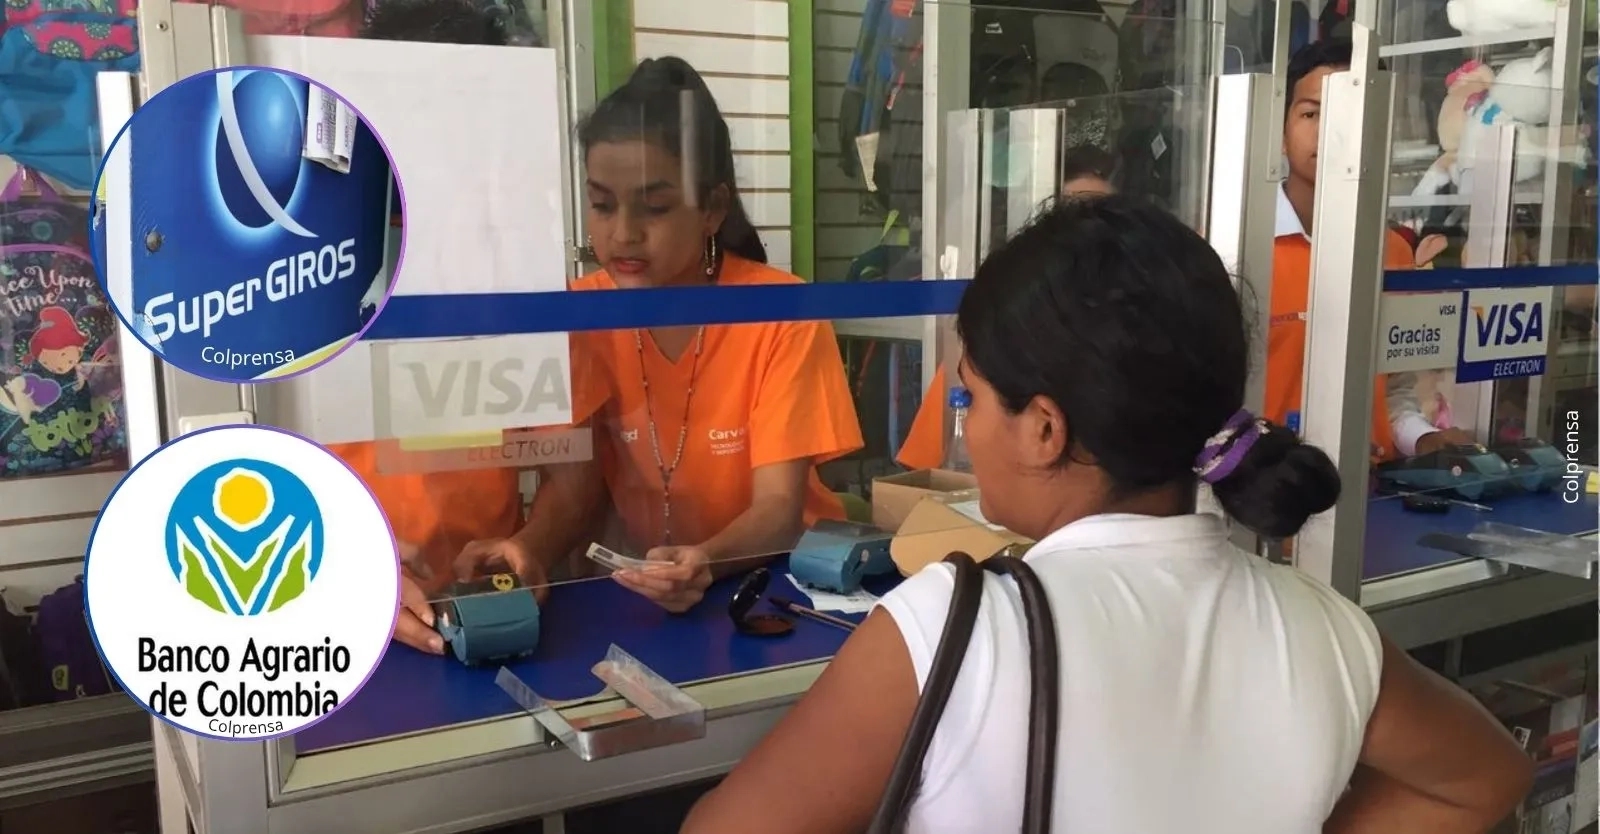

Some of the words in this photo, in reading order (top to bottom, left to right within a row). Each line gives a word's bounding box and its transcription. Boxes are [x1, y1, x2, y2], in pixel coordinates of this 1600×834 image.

[24, 266, 96, 297] Upon
[1439, 304, 1456, 316] VISA
[1388, 323, 1441, 345] Gracias
[1470, 302, 1543, 347] VISA
[1386, 349, 1402, 361] por
[1404, 347, 1414, 357] su
[1416, 344, 1440, 355] visita
[1493, 359, 1541, 377] ELECTRON
[396, 357, 570, 418] VISA
[467, 437, 571, 463] ELECTRON
